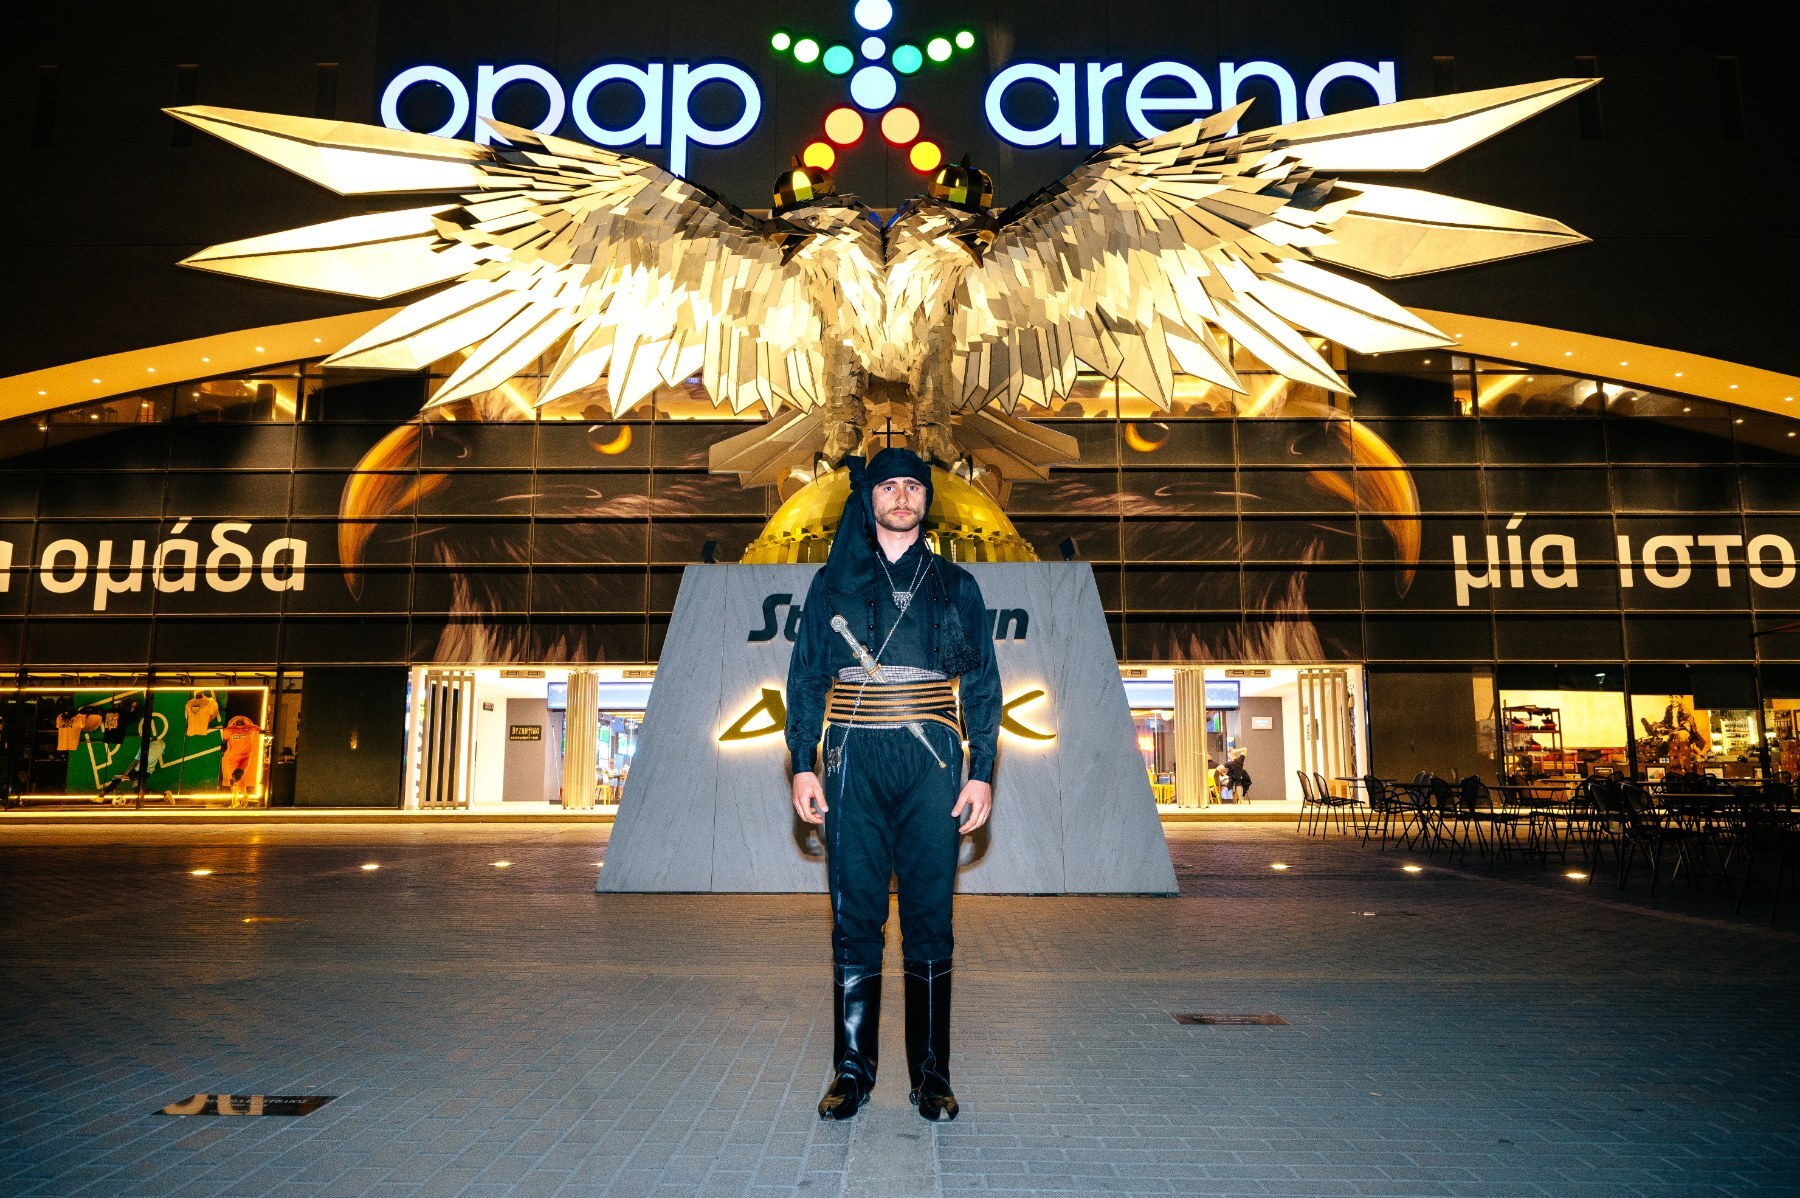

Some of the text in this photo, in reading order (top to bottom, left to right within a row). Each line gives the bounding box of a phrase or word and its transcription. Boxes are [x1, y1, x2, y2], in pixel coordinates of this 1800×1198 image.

[381, 63, 762, 178] opap
[40, 517, 307, 611] ομάδα
[1452, 513, 1578, 606] μία
